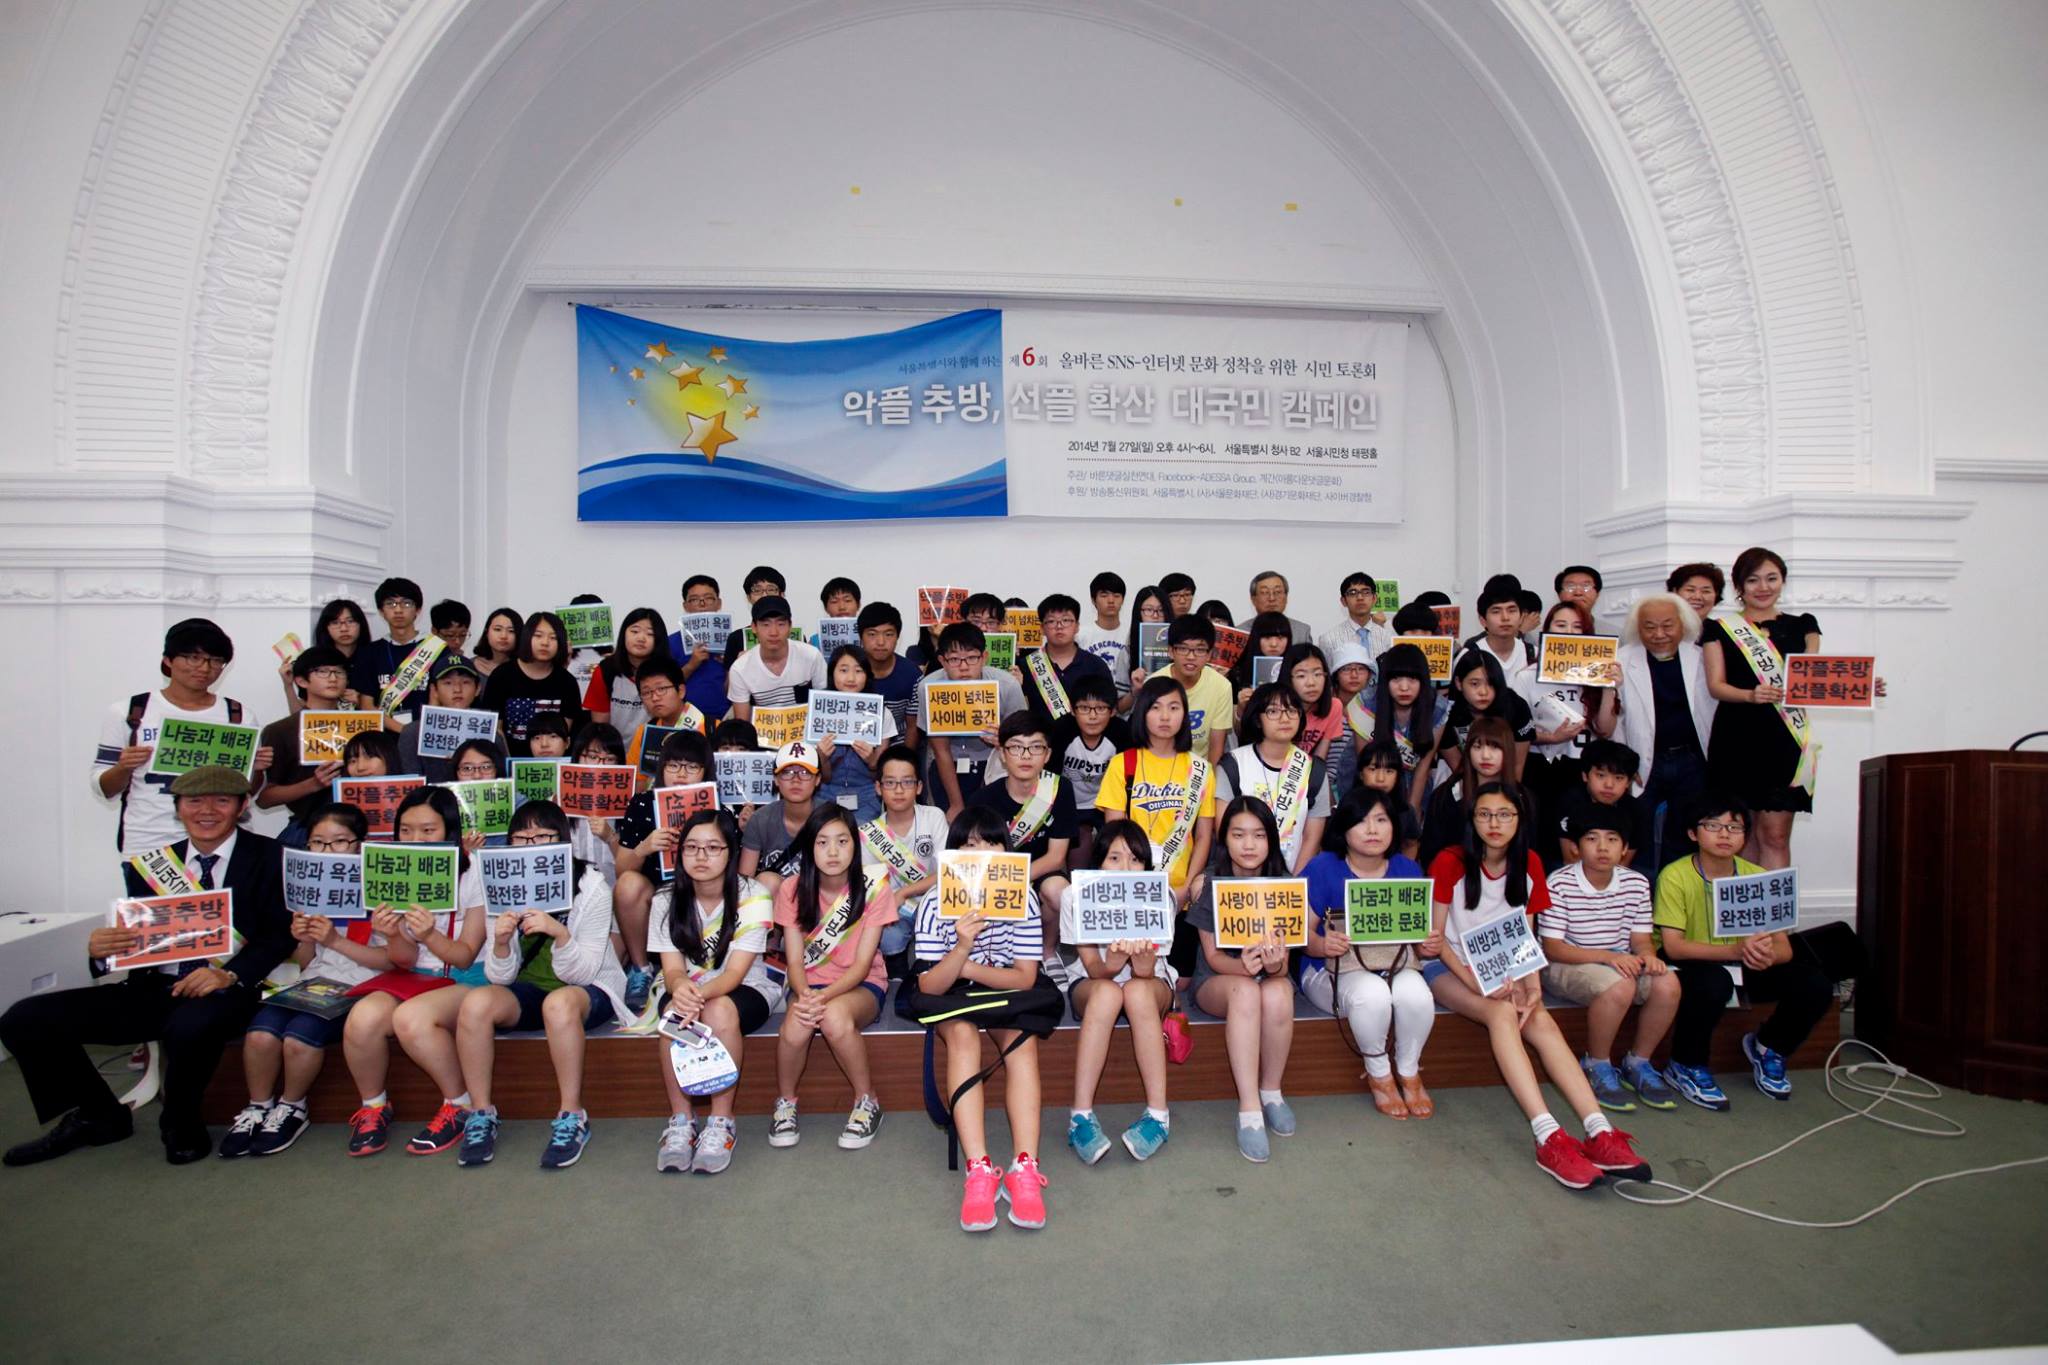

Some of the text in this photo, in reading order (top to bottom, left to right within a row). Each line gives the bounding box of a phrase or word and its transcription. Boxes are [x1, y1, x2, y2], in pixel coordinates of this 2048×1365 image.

[1059, 351, 1105, 370] 올바른
[1107, 354, 1185, 373] SNS-인터넷
[1189, 355, 1219, 374] 문화
[1222, 356, 1265, 376] 정착을
[1268, 358, 1298, 377] 위한
[1304, 359, 1332, 378] 시민
[1336, 360, 1377, 380] 토론회
[843, 381, 1377, 431] 악플 추방, 선플 확산 대국민 캠페인
[1067, 440, 1099, 453] 2014년
[1102, 440, 1116, 453] 7월
[1119, 441, 1153, 454] 27일(일)
[1156, 441, 1174, 454] 오후
[1225, 443, 1268, 457] 서울특별시
[1271, 444, 1288, 457] 청사
[1290, 446, 1301, 457] B2
[1306, 445, 1349, 459] 서울시민청
[1351, 446, 1378, 460] 태평홀
[991, 638, 1012, 653] 배려
[1424, 643, 1450, 656] 넘치는
[1546, 641, 1614, 658] 사랑이 넘치는
[1429, 660, 1449, 674] 공간
[1791, 660, 1871, 679] 악플추방
[930, 689, 996, 706] 사랑이 넘치는
[1789, 681, 1870, 701] 선플확산
[814, 698, 851, 715] 비방과
[425, 713, 493, 735] 비방과 욕설
[812, 718, 850, 735] 완전한
[931, 709, 967, 727] 사이버
[163, 724, 215, 747] 나눔과
[219, 731, 254, 751] 배려
[516, 767, 554, 783] 나눔과
[561, 769, 632, 790] 악플추방
[1131, 782, 1185, 799] Dickie
[562, 792, 630, 812] 선플확산
[484, 808, 511, 828] 문화
[286, 857, 361, 883] 비방과 욕설
[365, 852, 451, 876] 나눔과 배려
[483, 854, 565, 880] 비방과 욕설
[987, 864, 1025, 882] 넘치는
[285, 881, 361, 909] 완전한 퇴치
[365, 879, 451, 903] 건전한 문화
[486, 880, 565, 906] 완전한 퇴치
[993, 889, 1024, 910] 공간
[1081, 880, 1163, 904] 비방과 욕설
[1219, 890, 1303, 910] 사랑이 넘치는
[1350, 886, 1427, 908] 나눔과 배려
[1719, 875, 1794, 905] 비방과 욕설
[1082, 908, 1164, 931] 완전한 퇴치
[1351, 911, 1427, 934] 건전한 문화
[1719, 899, 1794, 929] 완전한 퇴치
[1220, 915, 1303, 938] 사이버 공간
[1466, 927, 1502, 956] 비방과
[1502, 914, 1527, 940] 욕설
